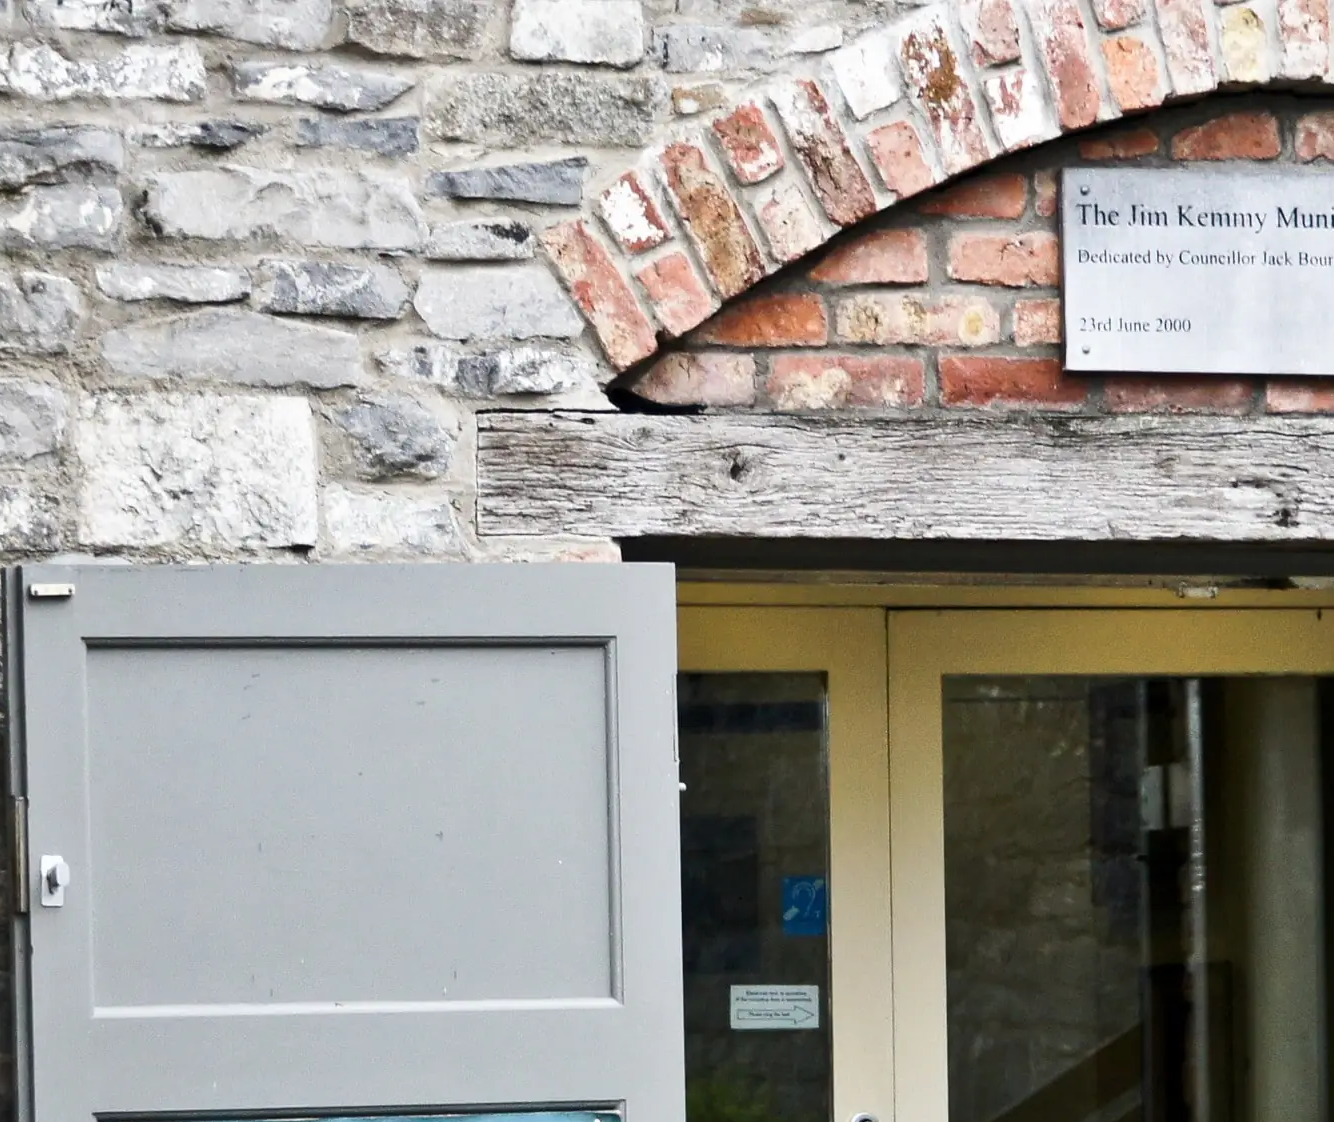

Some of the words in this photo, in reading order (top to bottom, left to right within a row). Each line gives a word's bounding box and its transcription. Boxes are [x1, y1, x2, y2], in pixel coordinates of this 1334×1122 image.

[1076, 203, 1120, 227] The
[1128, 204, 1168, 227] Jim
[1178, 205, 1267, 233] Kemmy
[1078, 249, 1152, 265] Dedicated
[1156, 249, 1174, 268] by
[1178, 249, 1256, 266] Councillor
[1262, 250, 1293, 266] Jack
[1079, 316, 1112, 332] 23rd
[1117, 317, 1150, 332] June
[1155, 318, 1192, 333] 2000
